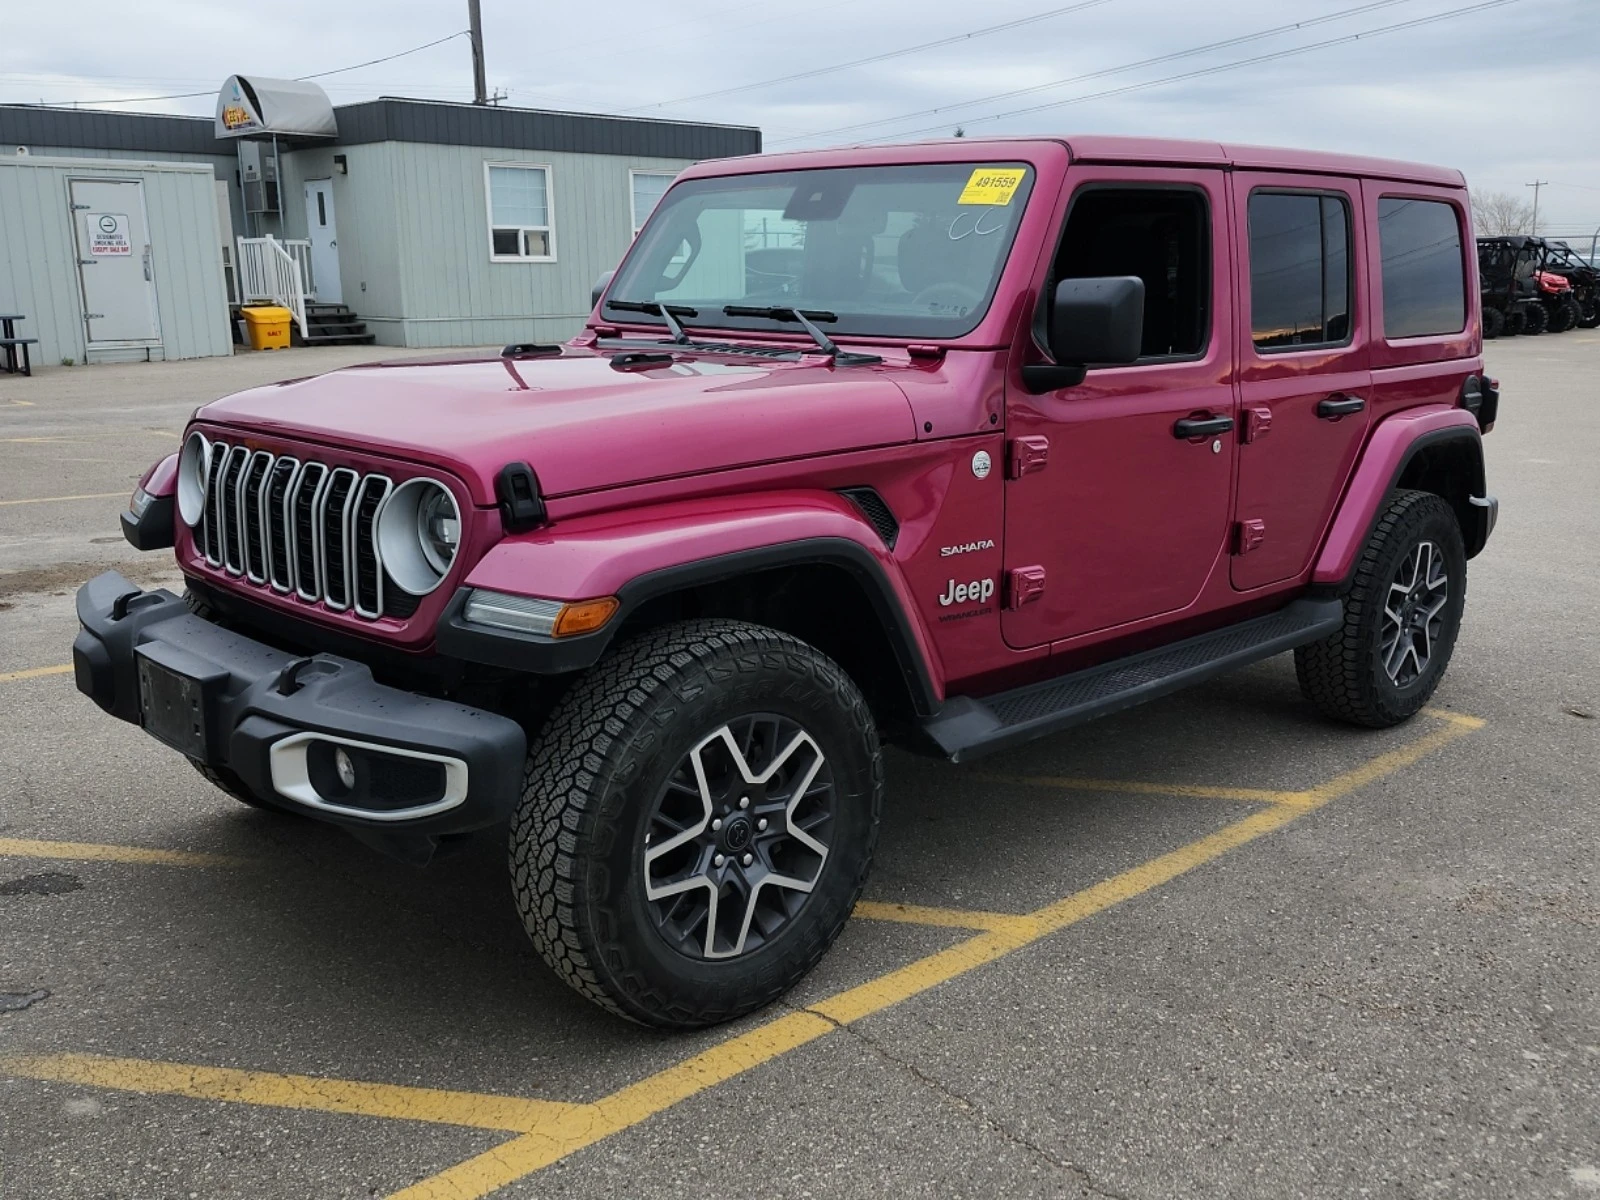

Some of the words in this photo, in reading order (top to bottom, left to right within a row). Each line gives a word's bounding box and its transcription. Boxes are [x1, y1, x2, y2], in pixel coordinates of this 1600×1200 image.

[975, 177, 1017, 188] 491559
[940, 539, 995, 557] SAHARA
[939, 578, 994, 606] Jeep
[938, 607, 992, 622] WRANGLER
